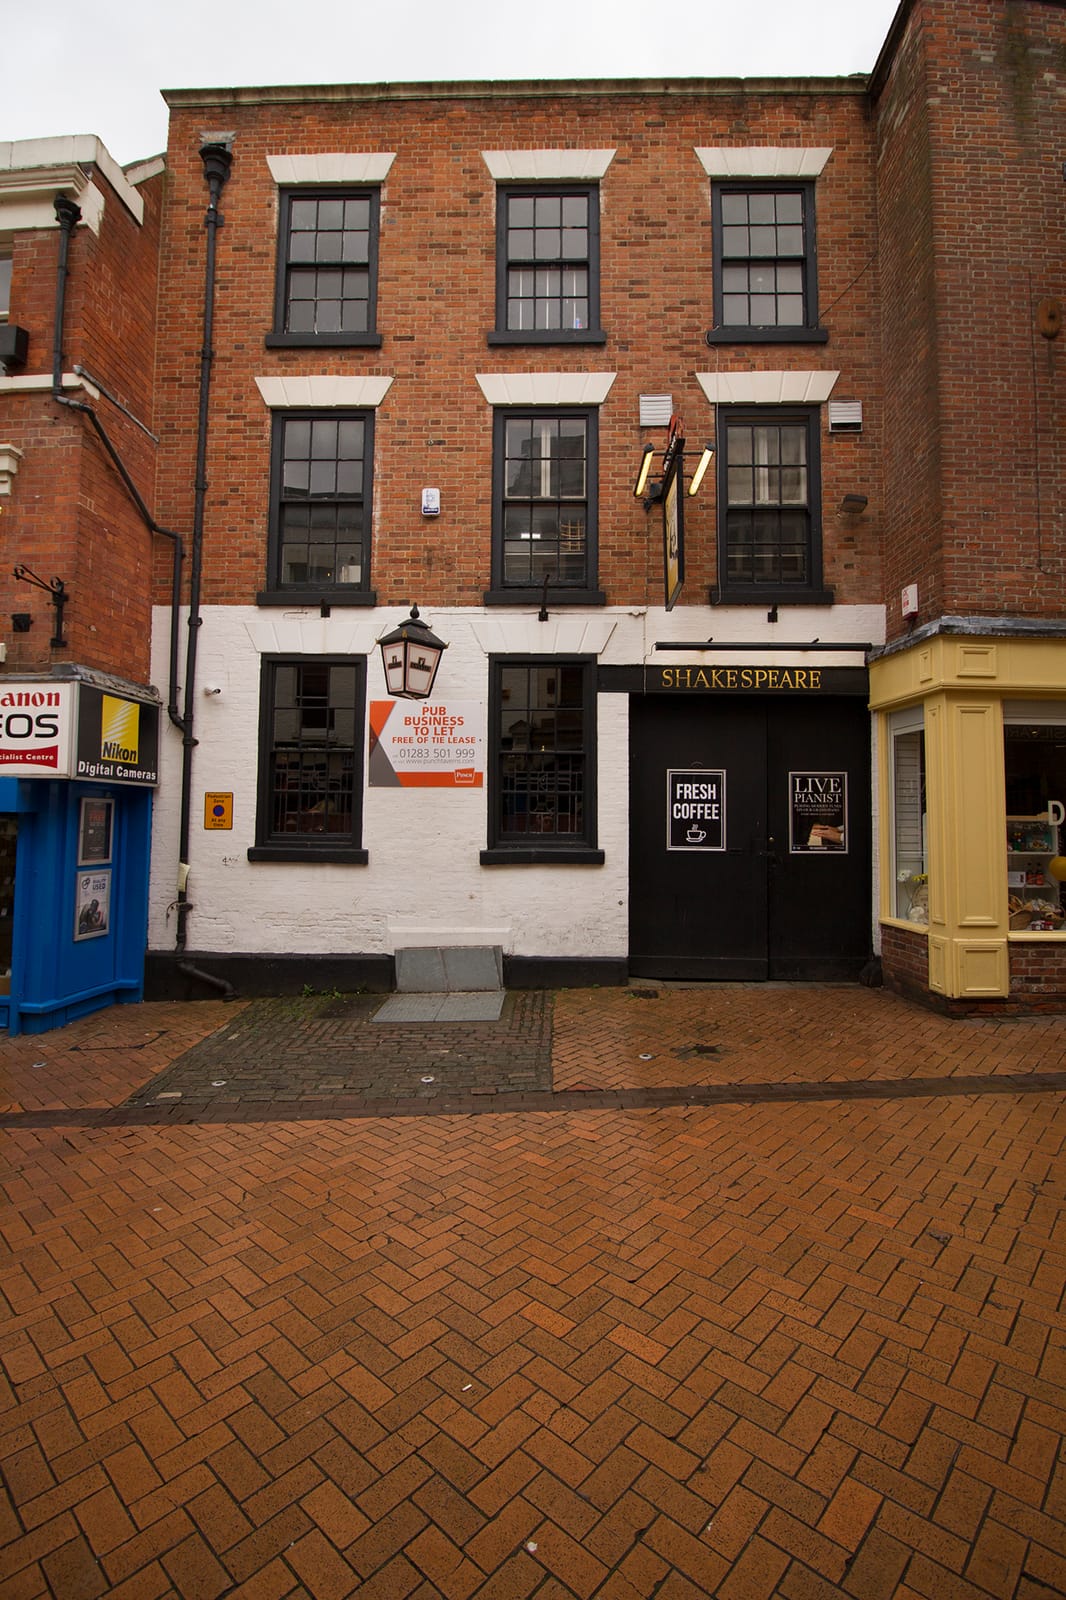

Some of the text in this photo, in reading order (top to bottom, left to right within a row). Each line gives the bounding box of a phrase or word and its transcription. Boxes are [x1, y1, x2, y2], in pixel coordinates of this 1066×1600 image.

[661, 669, 821, 689] SHAKESPEARE
[0, 692, 60, 707] anon
[422, 706, 447, 716] PUB
[0, 713, 59, 738] OS
[404, 716, 464, 726] BUSINESS
[413, 726, 455, 736] TO LET
[392, 736, 476, 744] FREE OF TIE LEASE
[26, 753, 54, 761] Centre
[102, 742, 137, 762] Nikon
[399, 748, 475, 758] 01283 501 999
[78, 761, 157, 780] Digital Cameras
[676, 783, 716, 800] FRESH
[794, 777, 842, 793] LIVE
[794, 793, 842, 803] PIANIST
[673, 803, 719, 820] COFFEE
[1047, 800, 1065, 826] D
